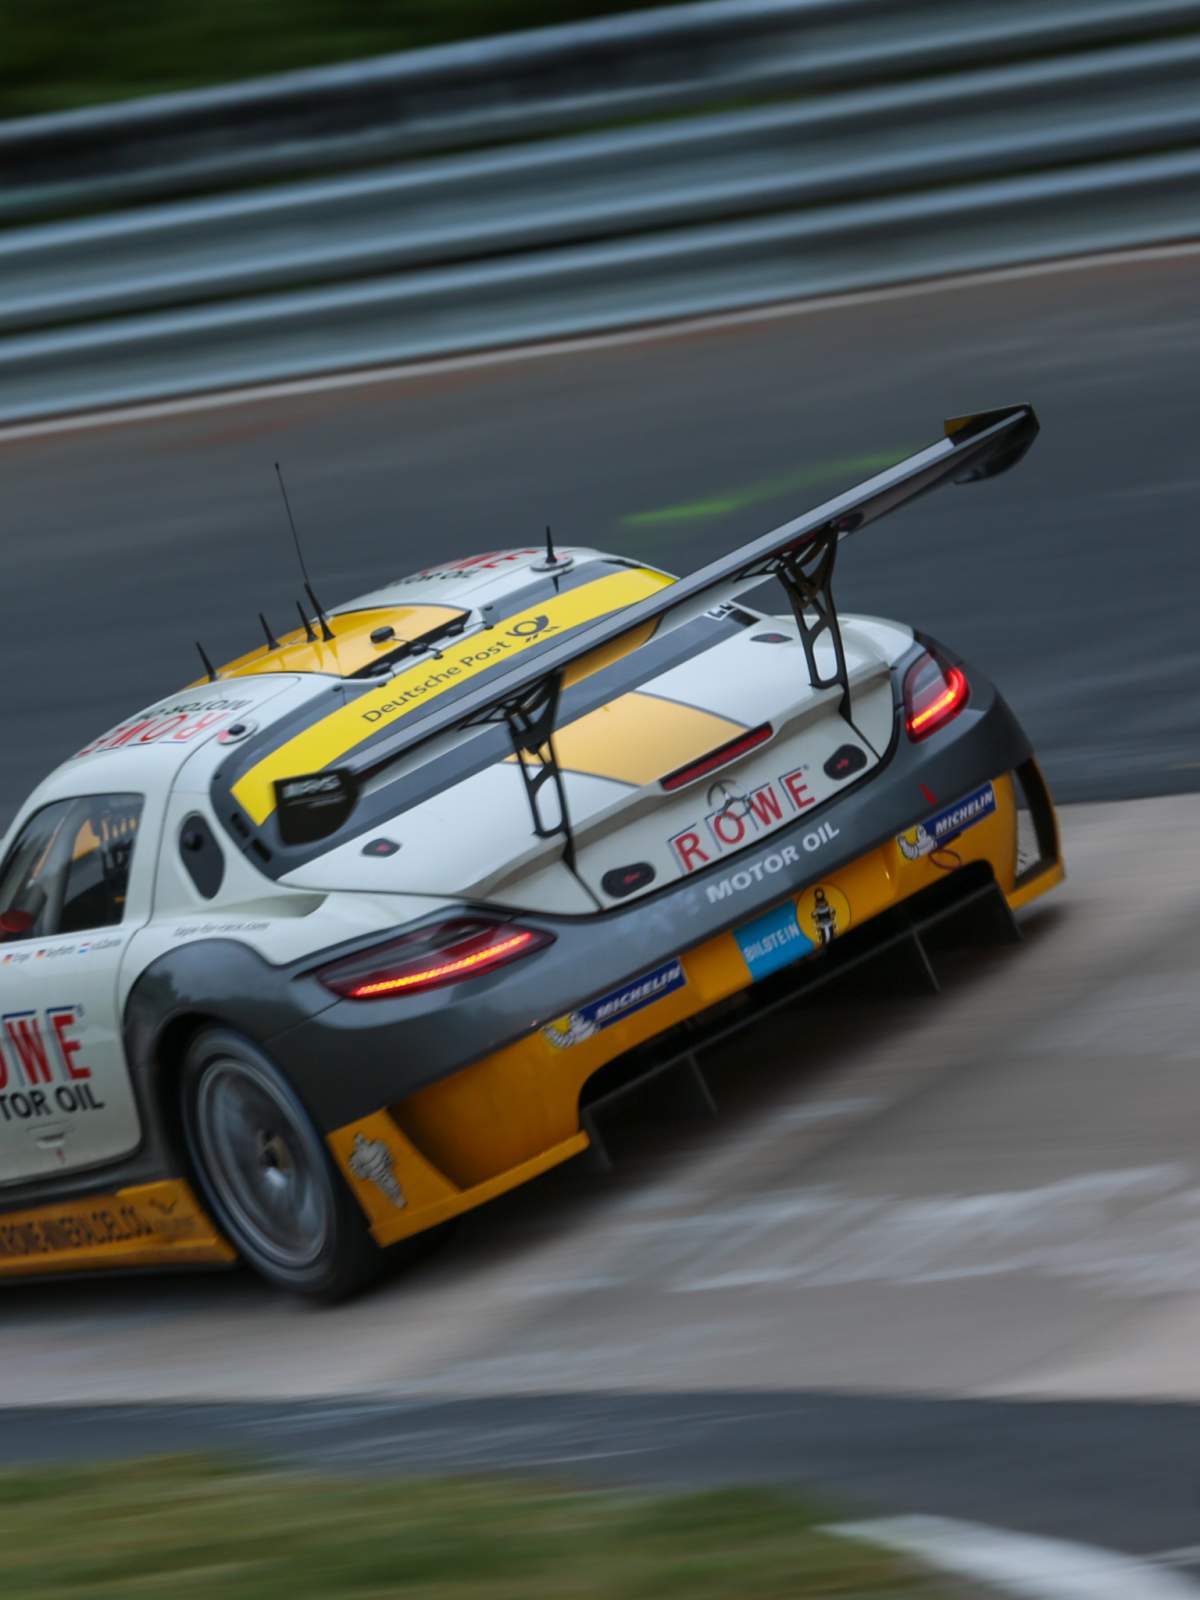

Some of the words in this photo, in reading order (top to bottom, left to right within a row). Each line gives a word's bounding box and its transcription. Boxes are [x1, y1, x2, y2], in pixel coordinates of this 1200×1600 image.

[362, 665, 462, 722] Deutsche
[460, 640, 512, 668] Post
[675, 772, 816, 873] ROWE
[935, 790, 993, 836] MICHELIN
[706, 846, 799, 903] MOTOR
[803, 822, 840, 852] OIL
[743, 922, 800, 962] BILSTEIN
[595, 964, 682, 1021] MICHELIN
[55, 1083, 106, 1123] OIL
